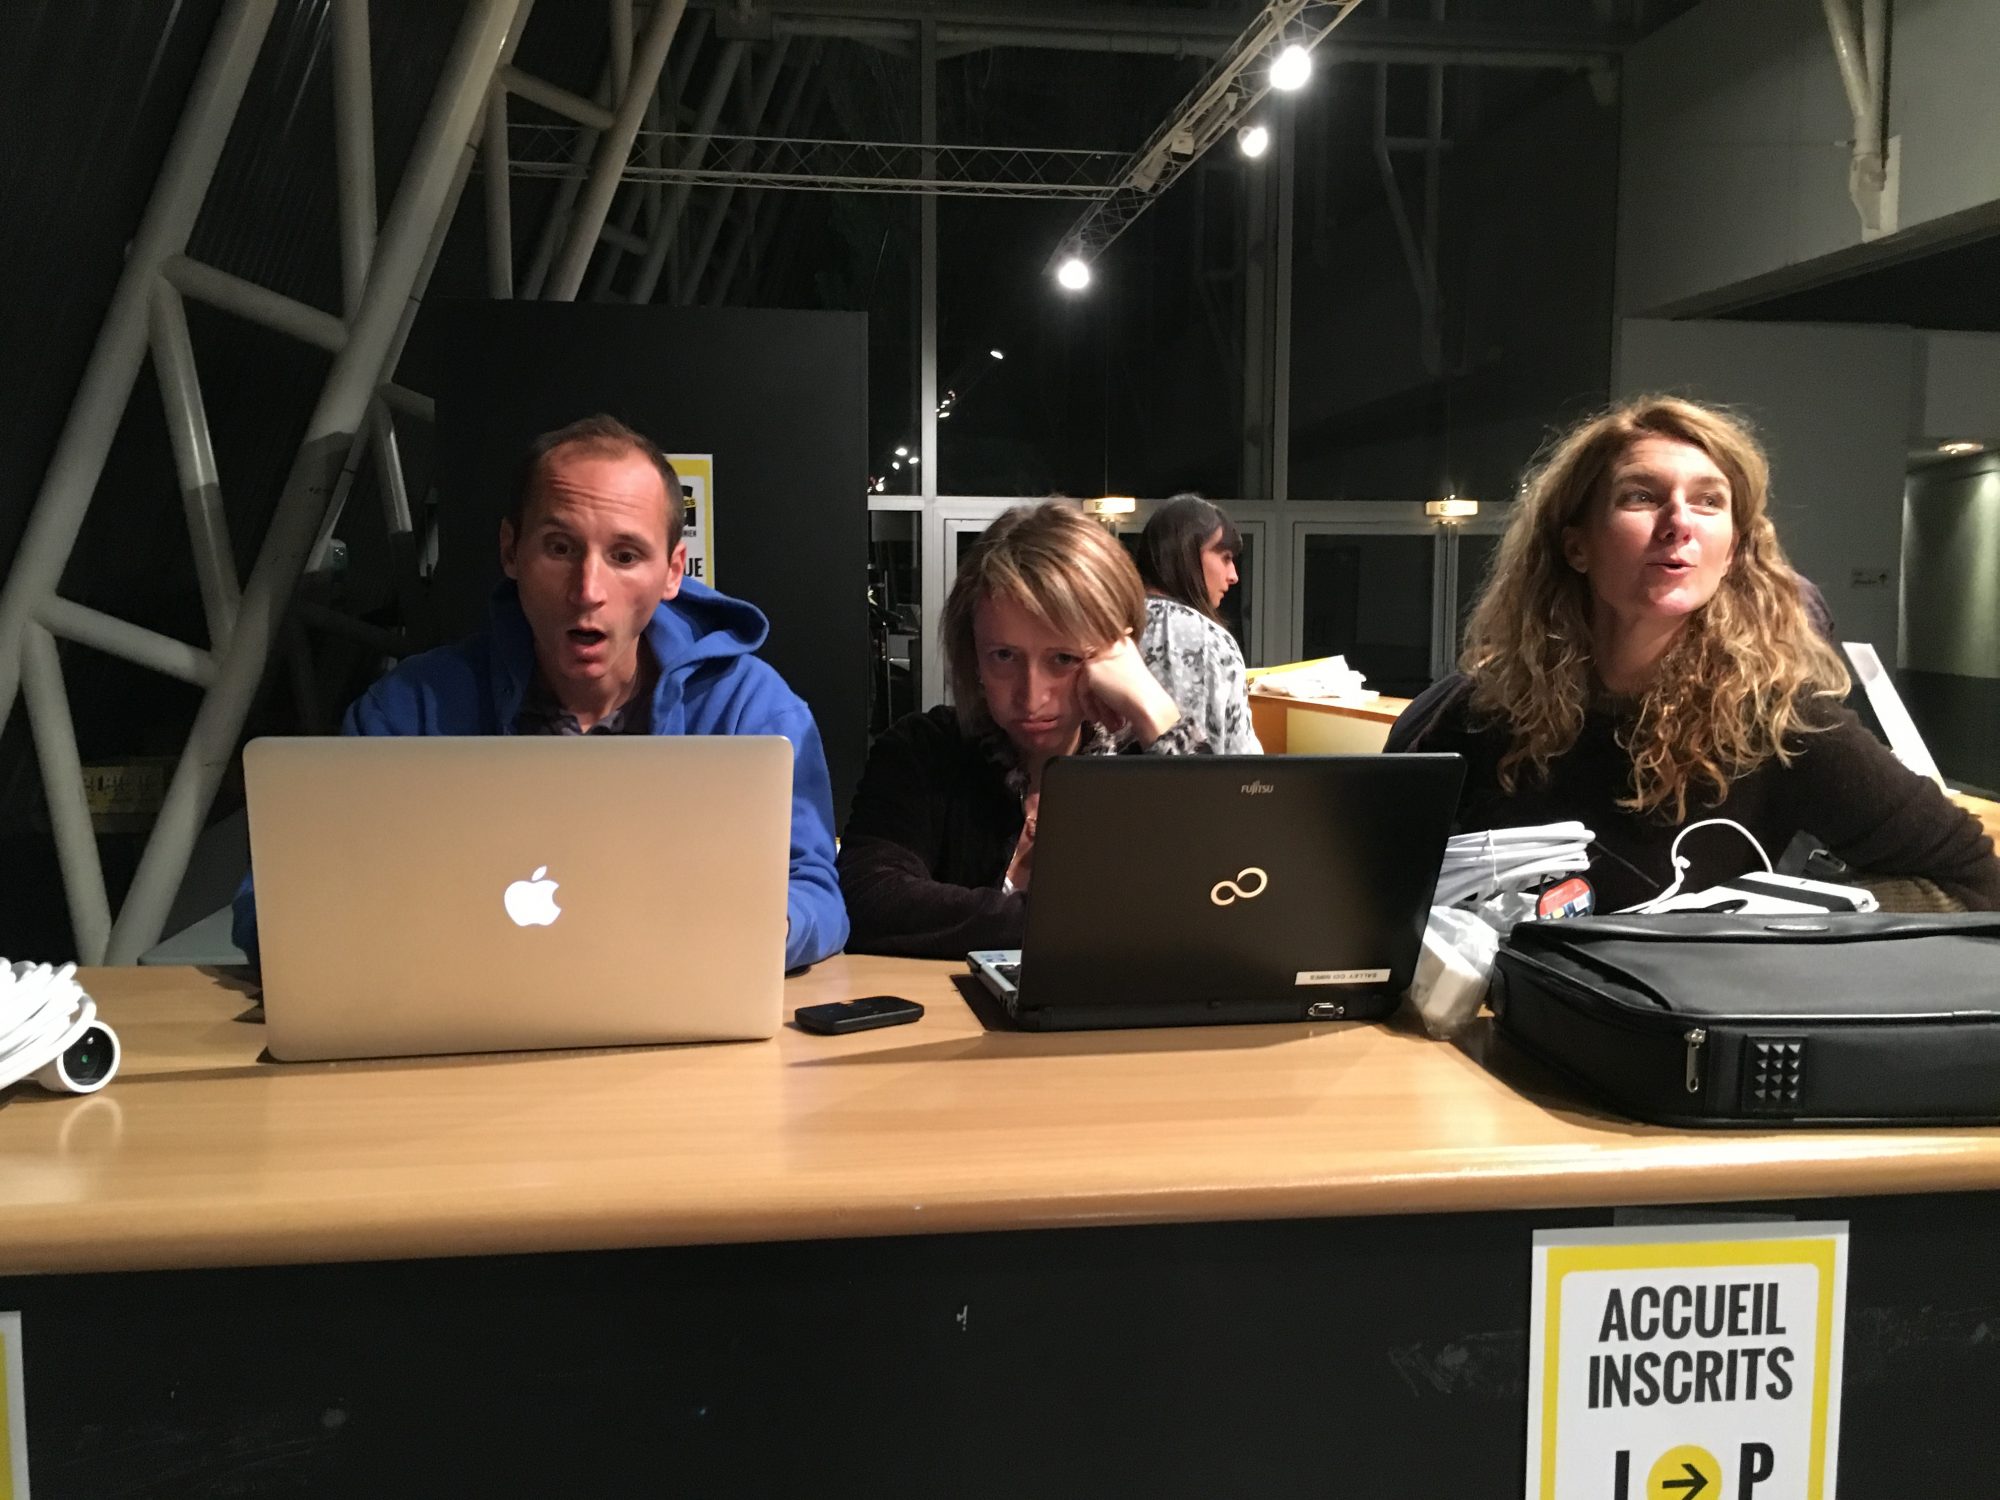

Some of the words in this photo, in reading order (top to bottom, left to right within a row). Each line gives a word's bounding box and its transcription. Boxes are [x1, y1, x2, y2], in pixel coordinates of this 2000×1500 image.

[1241, 779, 1274, 796] FUJITSU
[1598, 1282, 1787, 1343] ACCUEIL
[1588, 1346, 1795, 1410] INSCRITS
[1738, 1442, 1774, 1500] P
